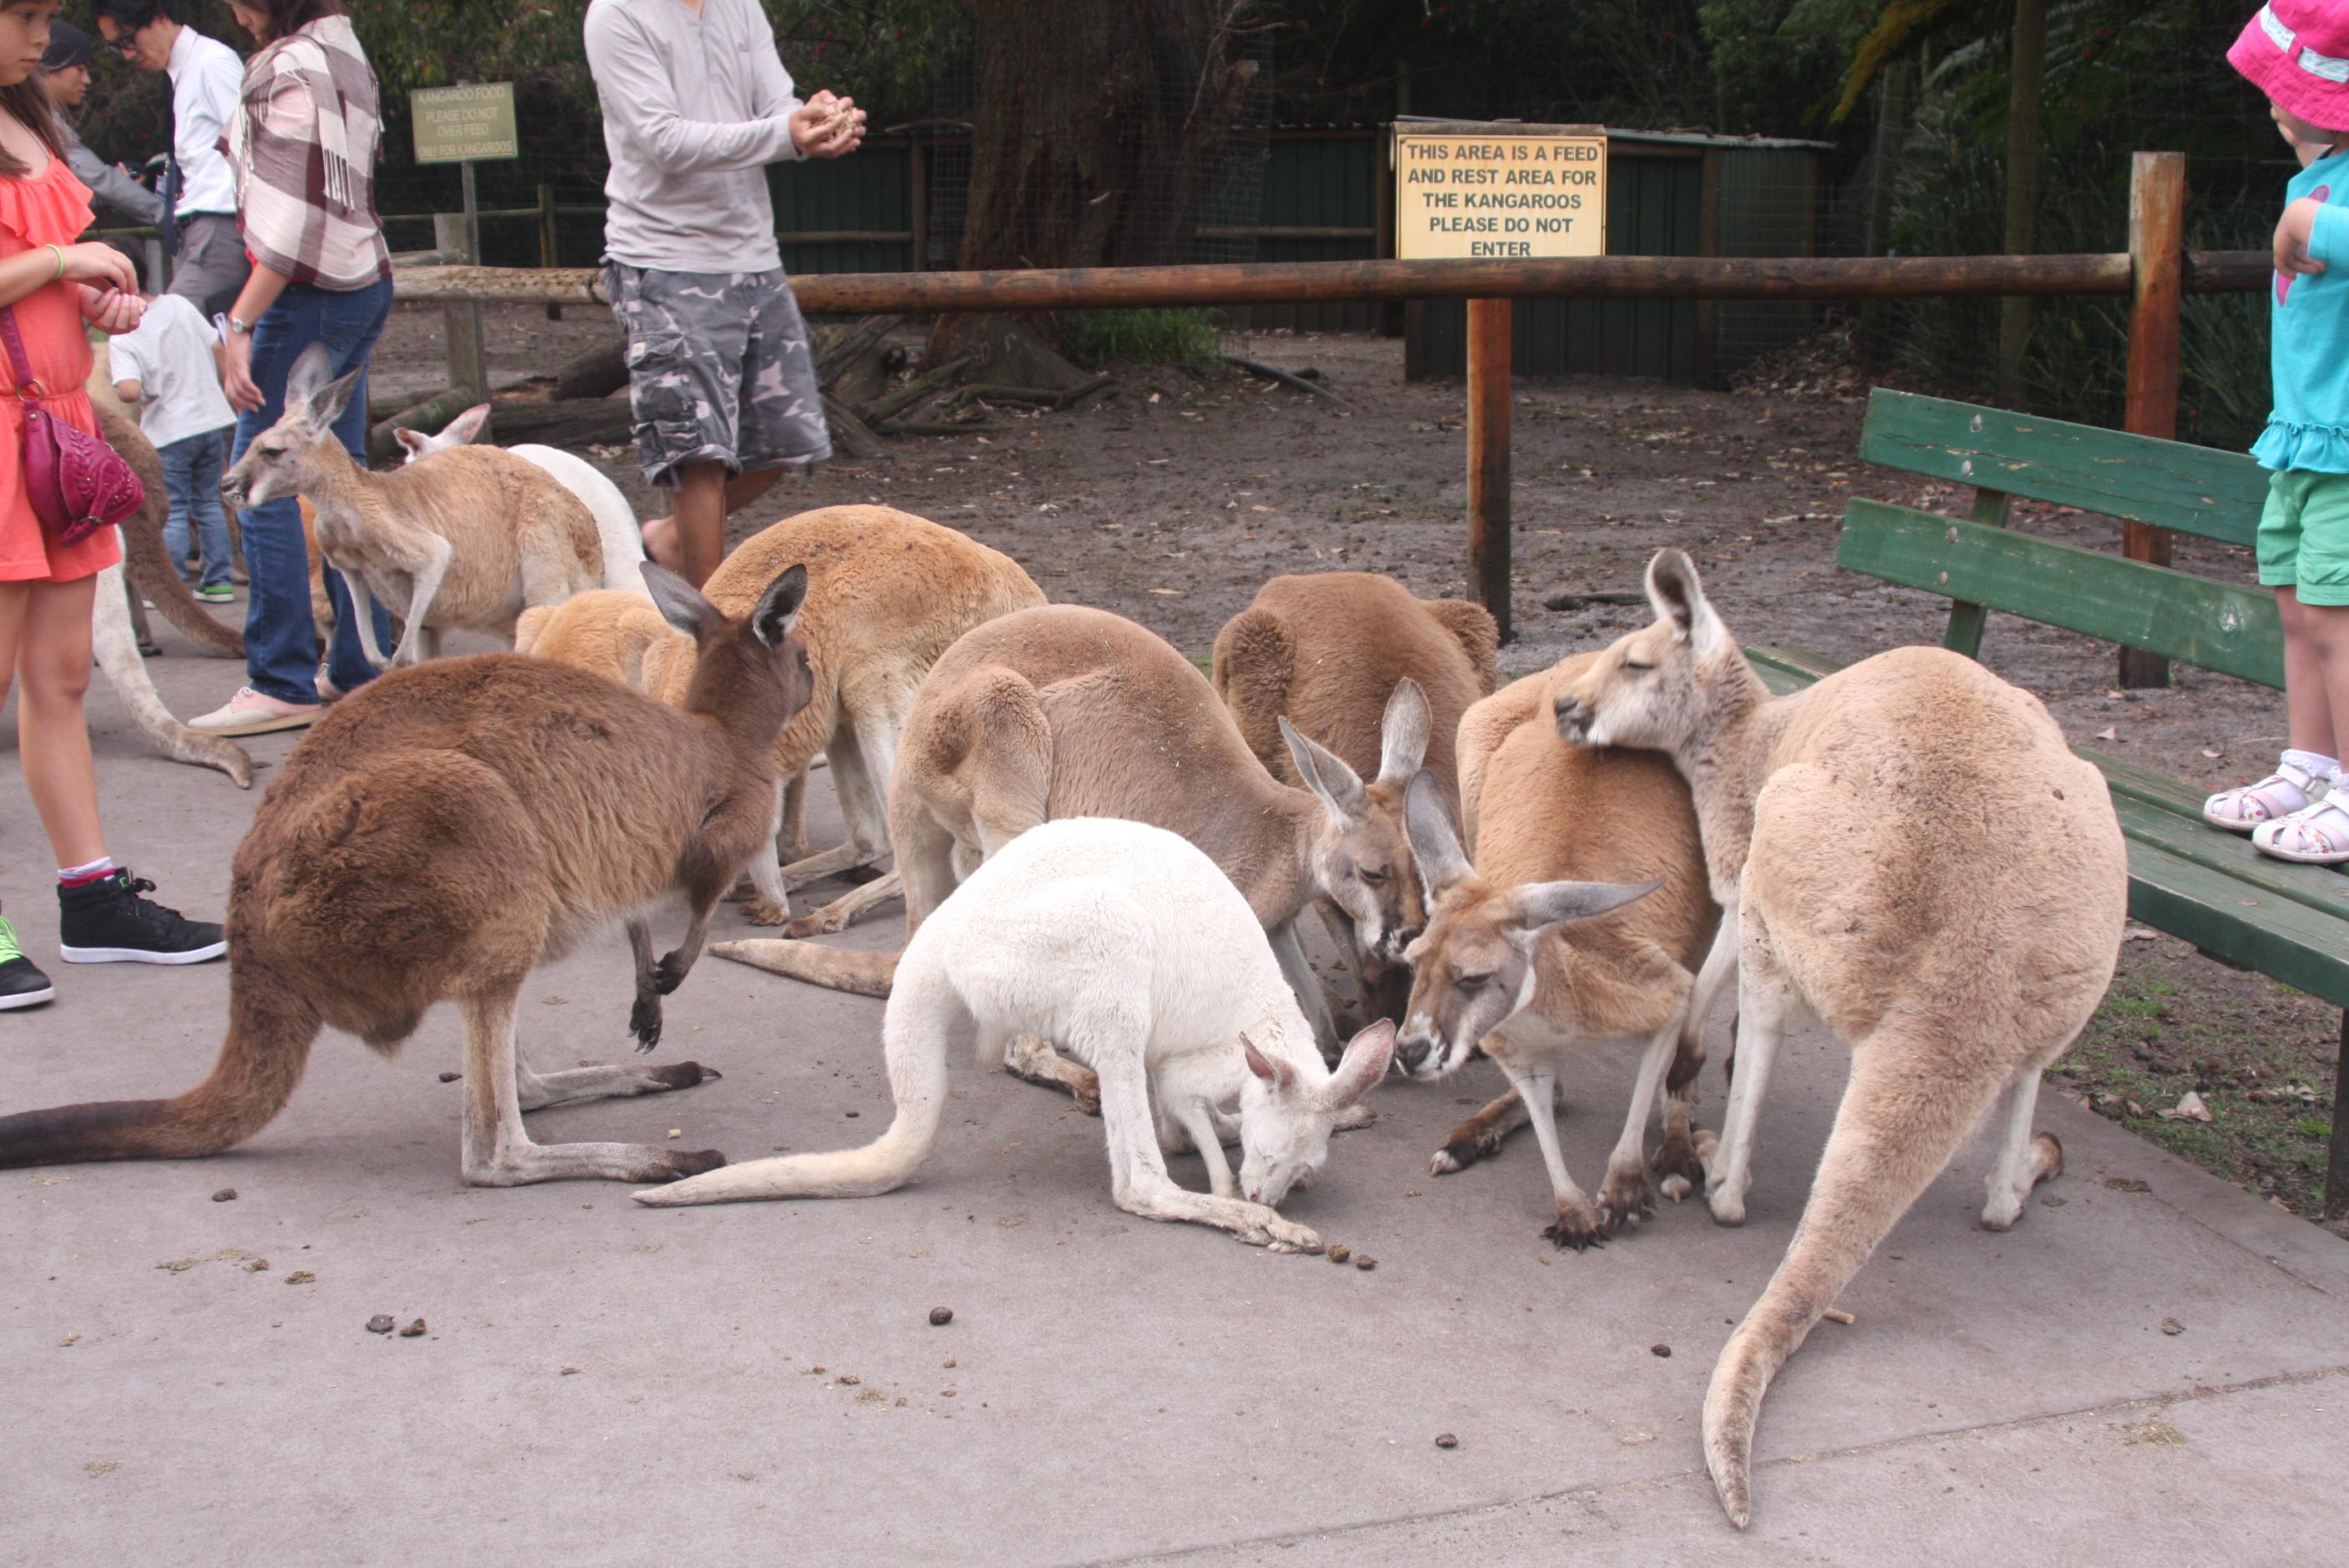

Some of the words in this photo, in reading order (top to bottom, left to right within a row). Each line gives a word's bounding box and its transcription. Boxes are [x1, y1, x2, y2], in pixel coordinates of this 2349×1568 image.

[418, 88, 474, 103] KANGAROO
[475, 87, 504, 98] FOOD
[426, 109, 460, 123] PLEASE
[462, 108, 475, 119] DO
[479, 107, 498, 118] NOT
[437, 125, 462, 137] OVER
[464, 123, 489, 135] FEED
[440, 144, 455, 155] FOR
[458, 141, 512, 153] KANGAROOS
[1407, 144, 1448, 159] THIS
[1455, 145, 1505, 160] AREA
[1512, 146, 1528, 160] IS
[1535, 146, 1547, 160] A
[1554, 146, 1598, 161] FEED
[1408, 168, 1445, 183] AND
[1451, 169, 1498, 183] REST
[1505, 170, 1555, 184] AREA
[1562, 170, 1597, 184] FOR
[1423, 193, 1458, 208] THE
[1465, 193, 1582, 209] KANGAROOS
[1430, 217, 1498, 232] PLEASE
[1505, 218, 1529, 232] DO
[1536, 218, 1573, 233] NOT
[1471, 241, 1531, 256] ENTER
